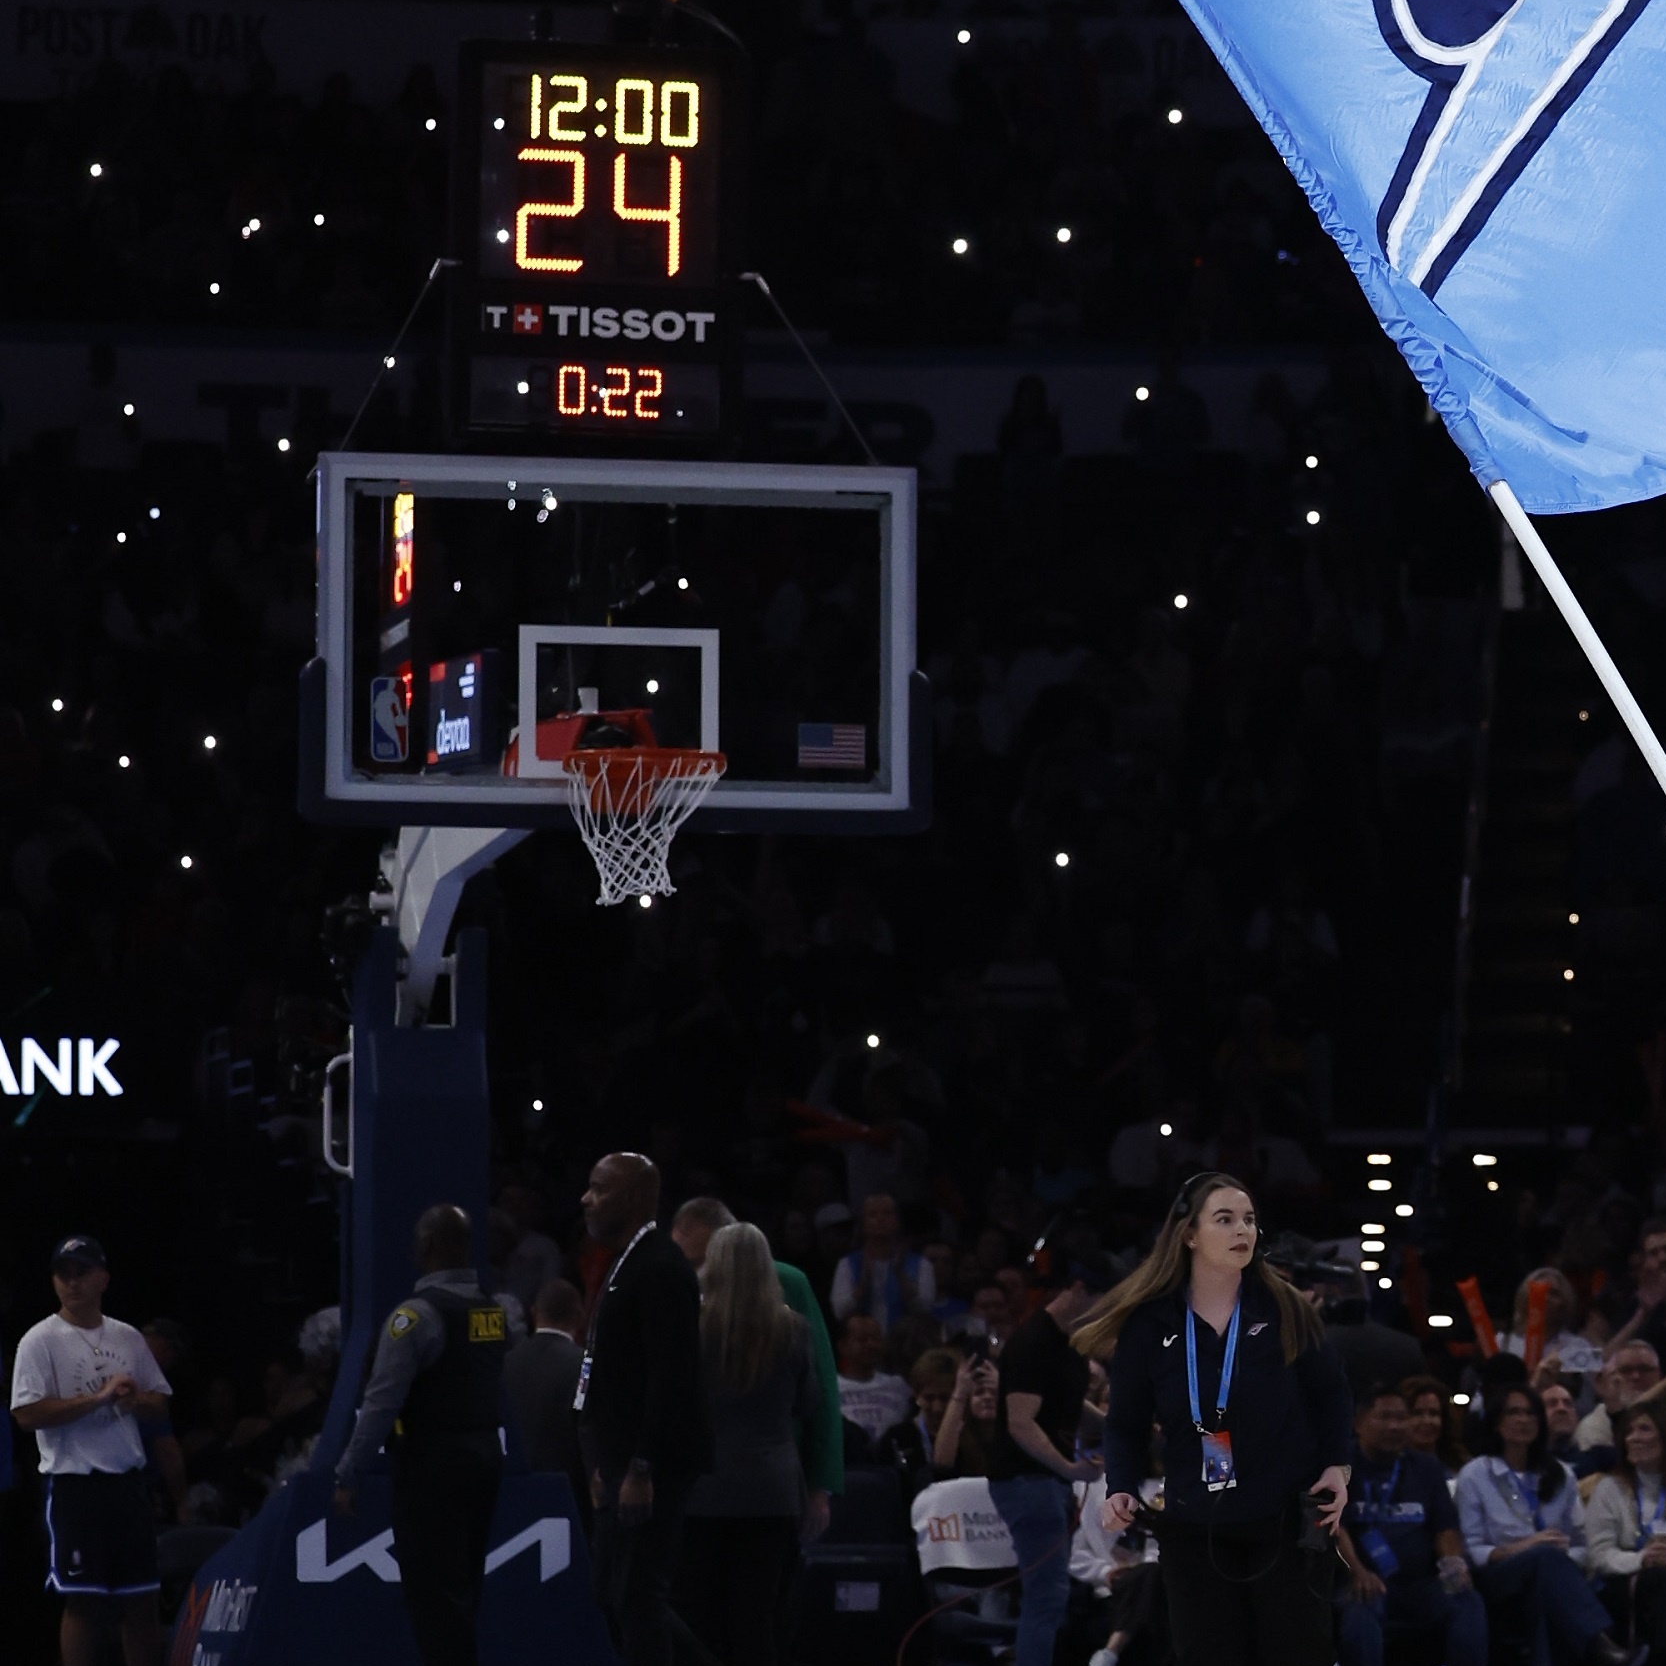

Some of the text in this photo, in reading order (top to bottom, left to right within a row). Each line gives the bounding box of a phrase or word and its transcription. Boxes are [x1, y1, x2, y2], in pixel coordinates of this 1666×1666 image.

[17, 5, 266, 63] POST OAK
[529, 73, 700, 148] 12:00
[515, 146, 683, 278] 24
[548, 304, 716, 343] TISSOT
[557, 364, 664, 419] 0:22
